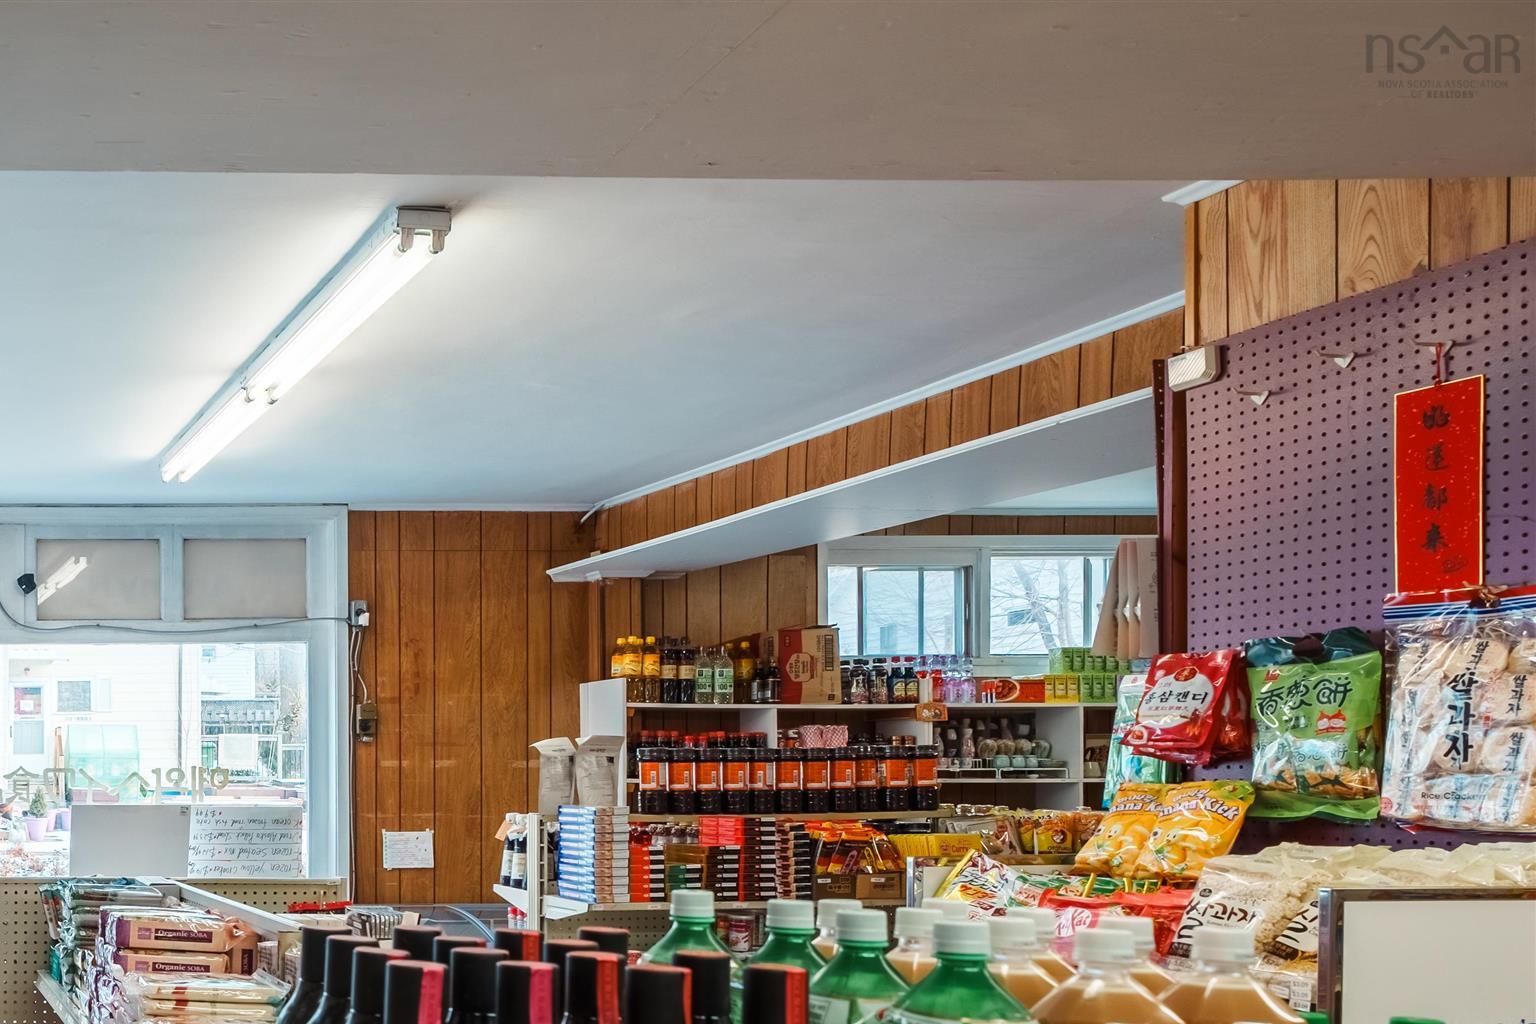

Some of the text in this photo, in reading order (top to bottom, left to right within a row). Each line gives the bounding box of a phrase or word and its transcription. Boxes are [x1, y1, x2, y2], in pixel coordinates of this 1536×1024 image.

[1442, 671, 1479, 763] 쌀과자
[1421, 791, 1440, 800] Rice
[1203, 796, 1239, 821] Kick
[158, 930, 189, 939] Organic
[155, 963, 186, 973] Organic
